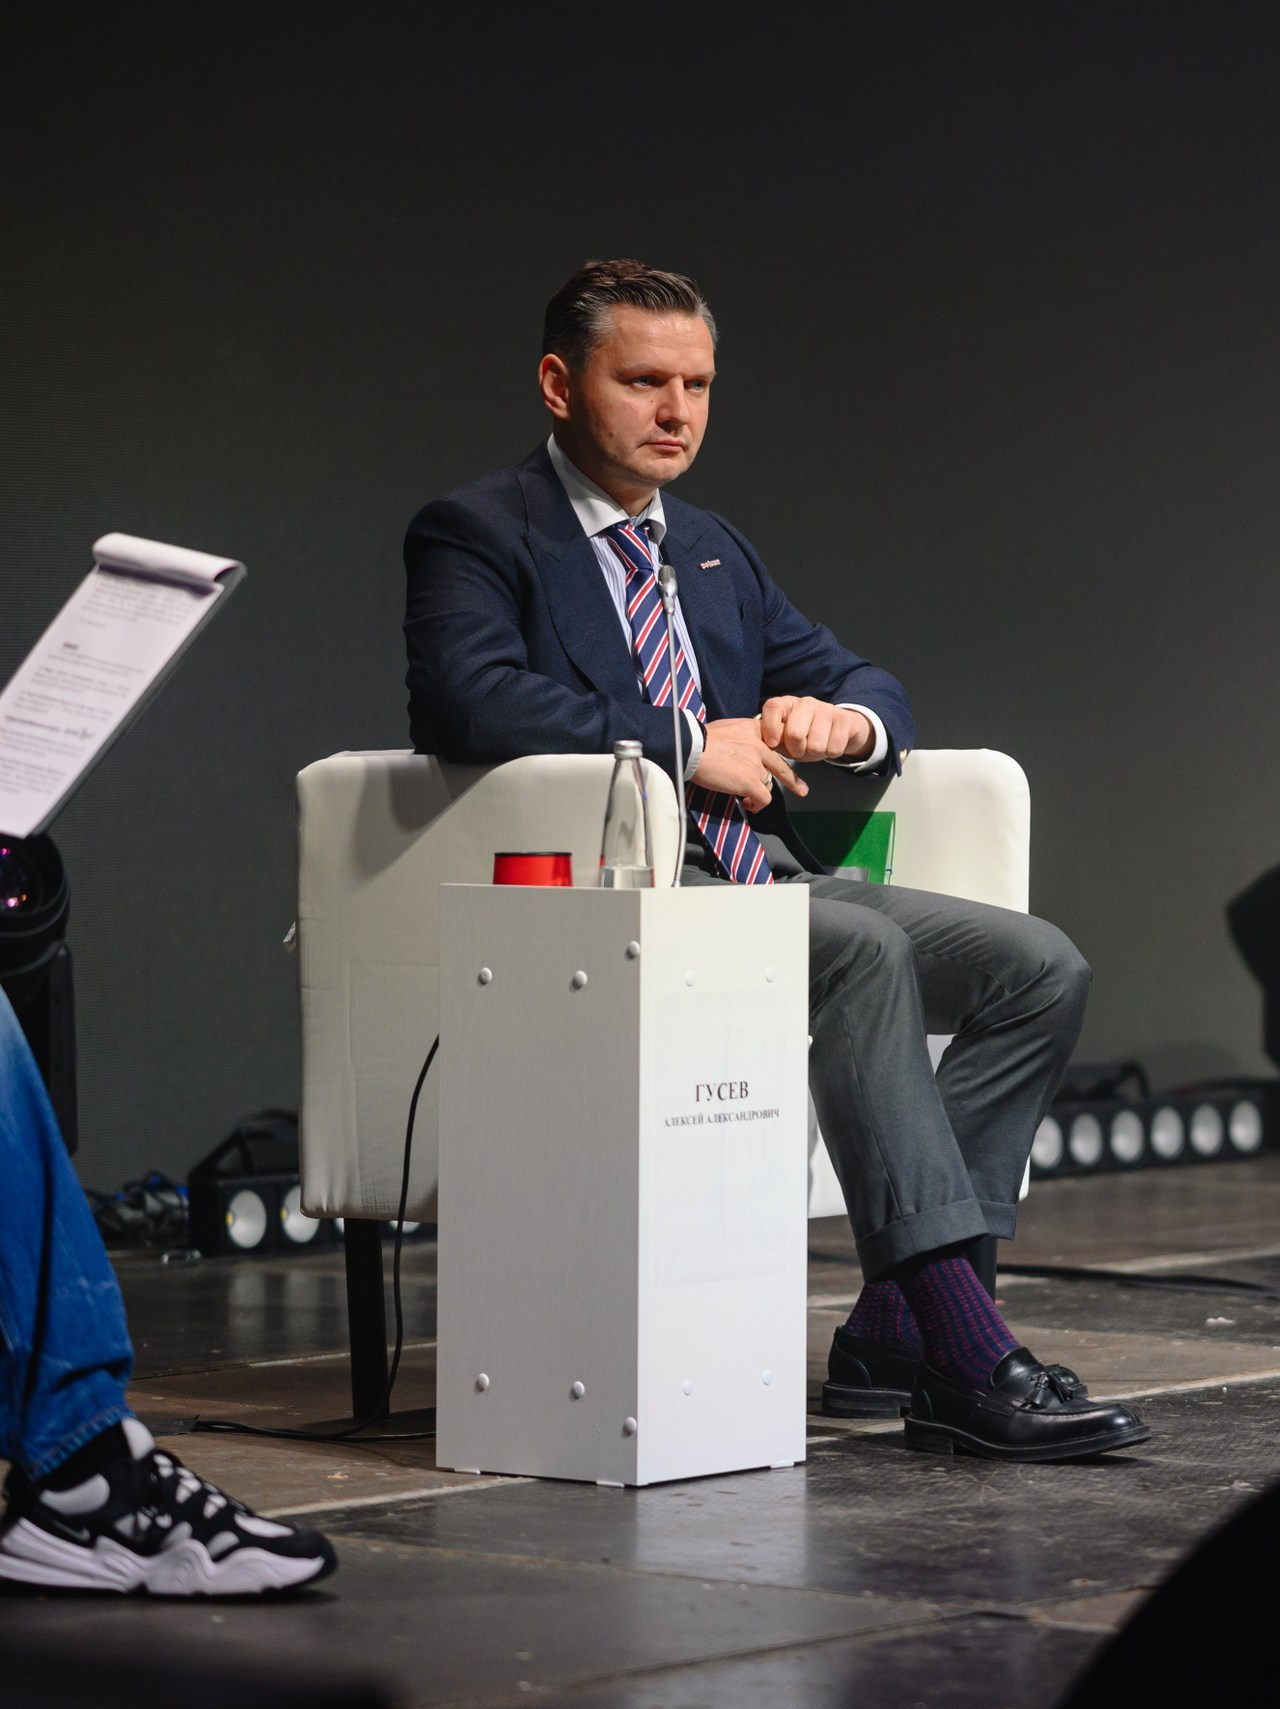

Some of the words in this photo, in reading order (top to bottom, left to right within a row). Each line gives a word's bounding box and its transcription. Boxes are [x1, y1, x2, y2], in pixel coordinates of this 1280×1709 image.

[695, 1081, 749, 1103] ГУСЕВ
[664, 1113, 704, 1127] АЛЕКСЕЙ
[706, 1108, 780, 1123] АЛЕКСАНДРОВИЧ
